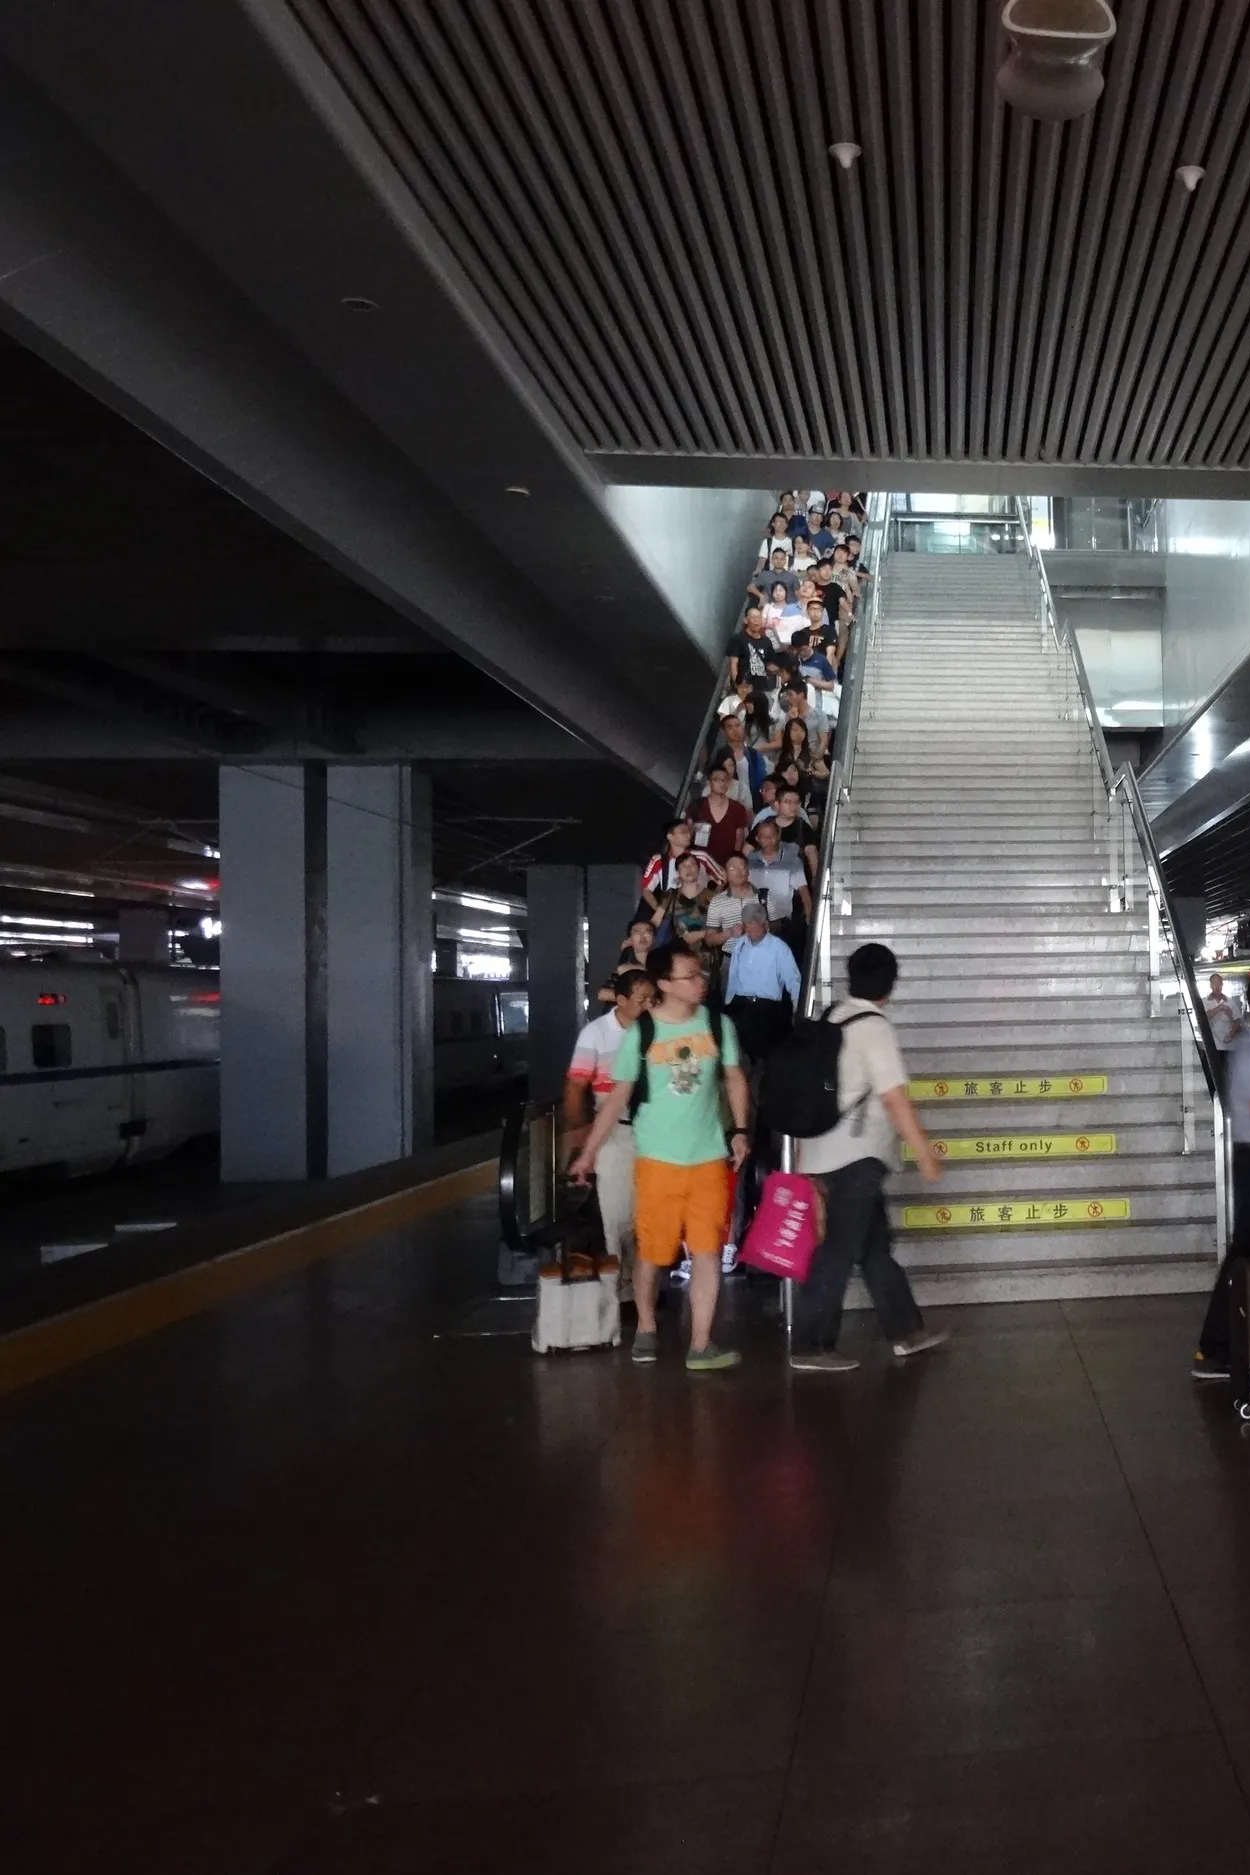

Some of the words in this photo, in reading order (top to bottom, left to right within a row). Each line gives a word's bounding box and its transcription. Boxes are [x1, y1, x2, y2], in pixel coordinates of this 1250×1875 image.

[964, 1079, 1053, 1096] 旅客止步
[975, 1140, 1014, 1153] Staff
[1019, 1139, 1053, 1154] only
[970, 1203, 1069, 1223] 旅客止步
